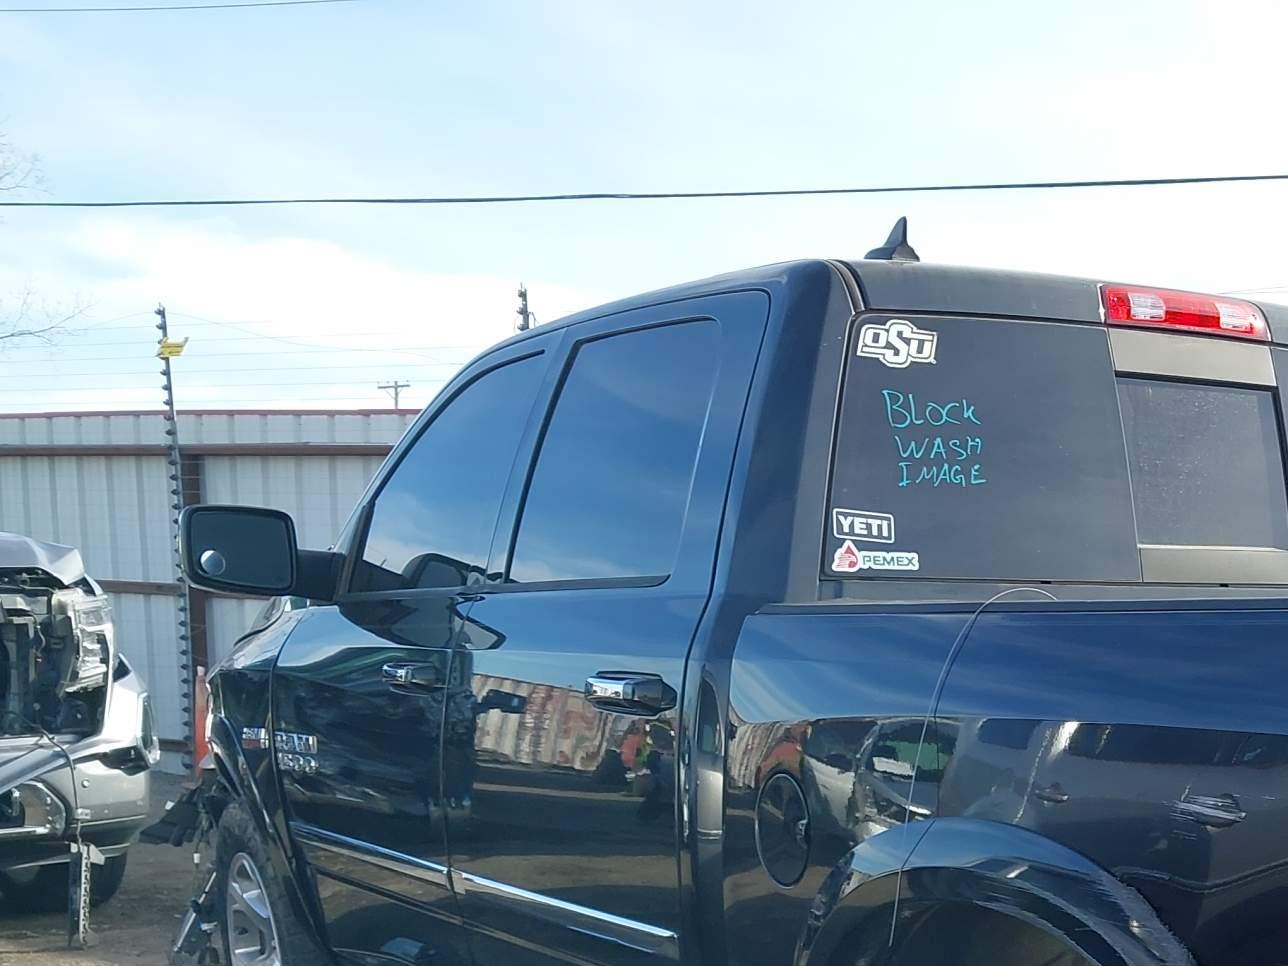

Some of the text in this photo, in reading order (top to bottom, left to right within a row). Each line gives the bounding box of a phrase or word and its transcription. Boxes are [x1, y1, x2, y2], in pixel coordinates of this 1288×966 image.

[857, 321, 936, 367] OSU
[895, 435, 982, 461] WASH
[898, 462, 987, 487] IMAGE
[837, 514, 890, 538] YETI
[862, 554, 916, 568] PEMEX
